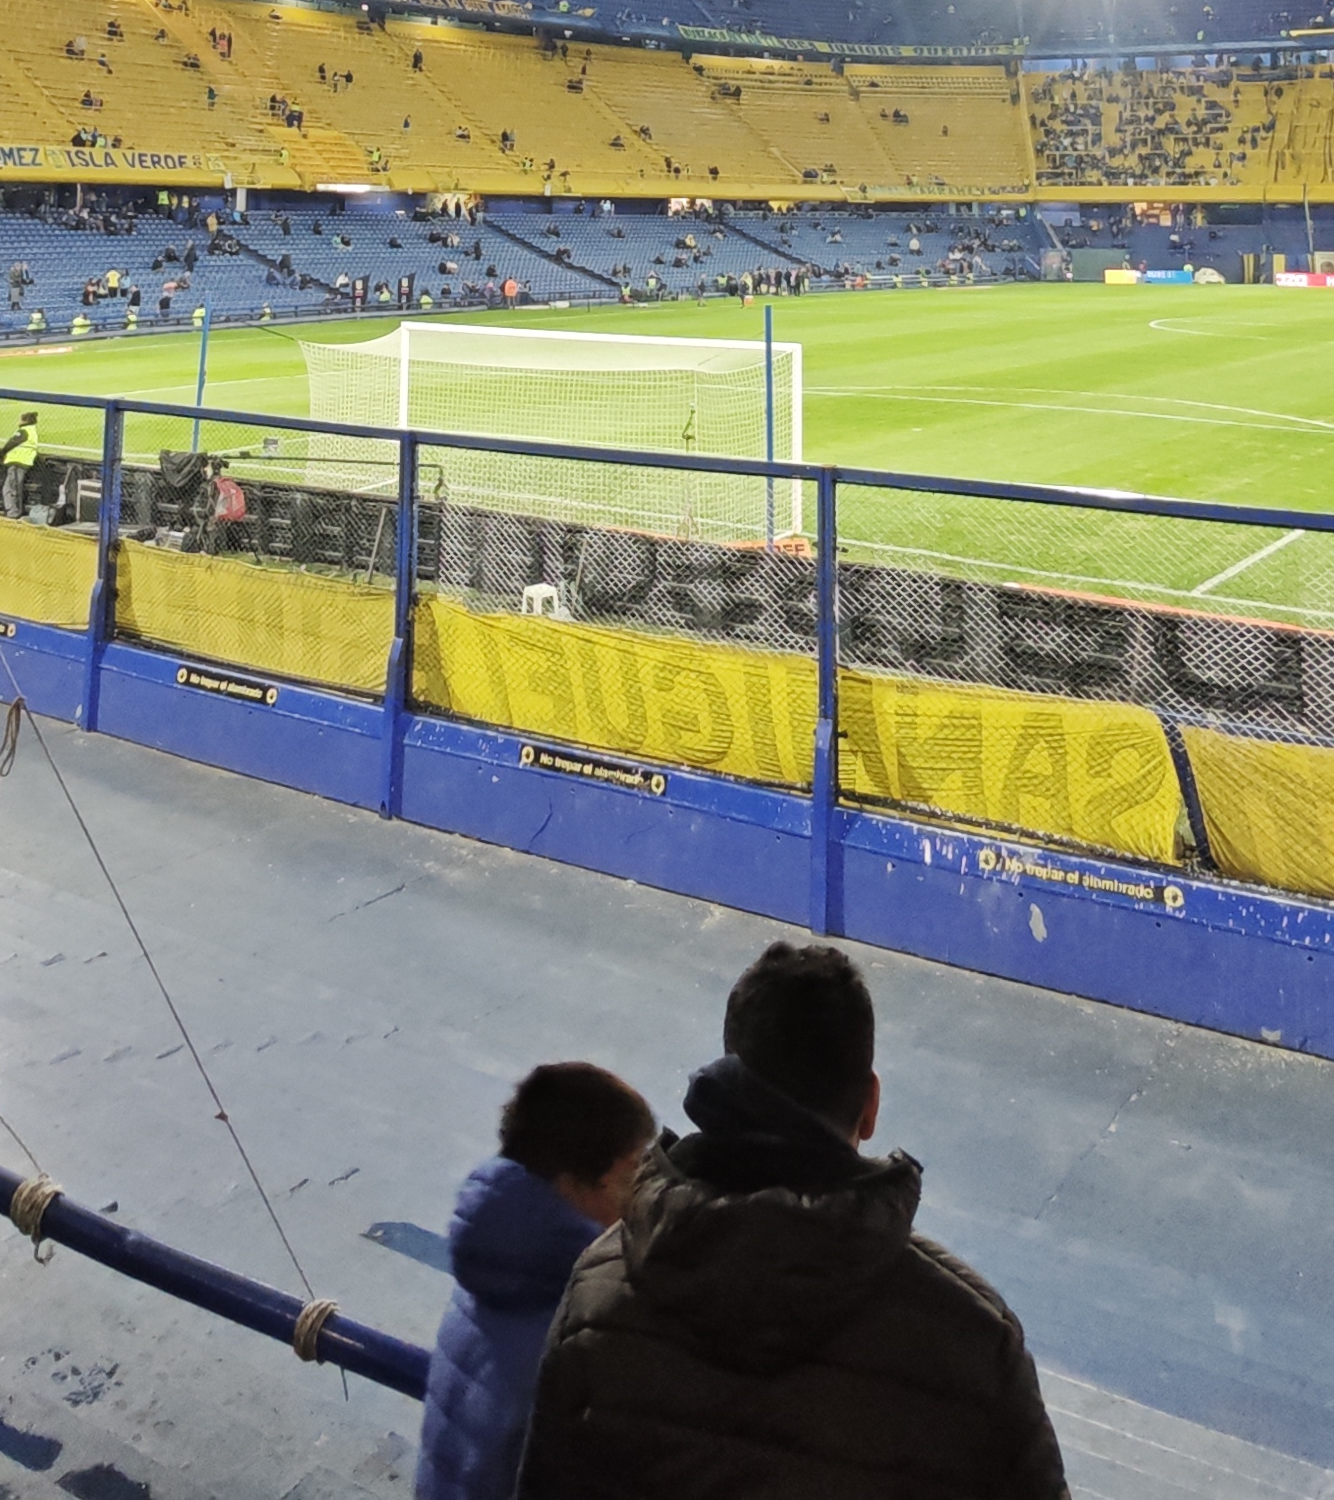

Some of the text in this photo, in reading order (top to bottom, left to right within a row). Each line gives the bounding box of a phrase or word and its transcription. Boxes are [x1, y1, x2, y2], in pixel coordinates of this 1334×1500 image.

[65, 150, 119, 168] ISLA
[122, 152, 188, 170] VERDE
[539, 752, 554, 766] No
[582, 763, 593, 775] el
[1004, 857, 1024, 873] No
[1066, 870, 1080, 885] el
